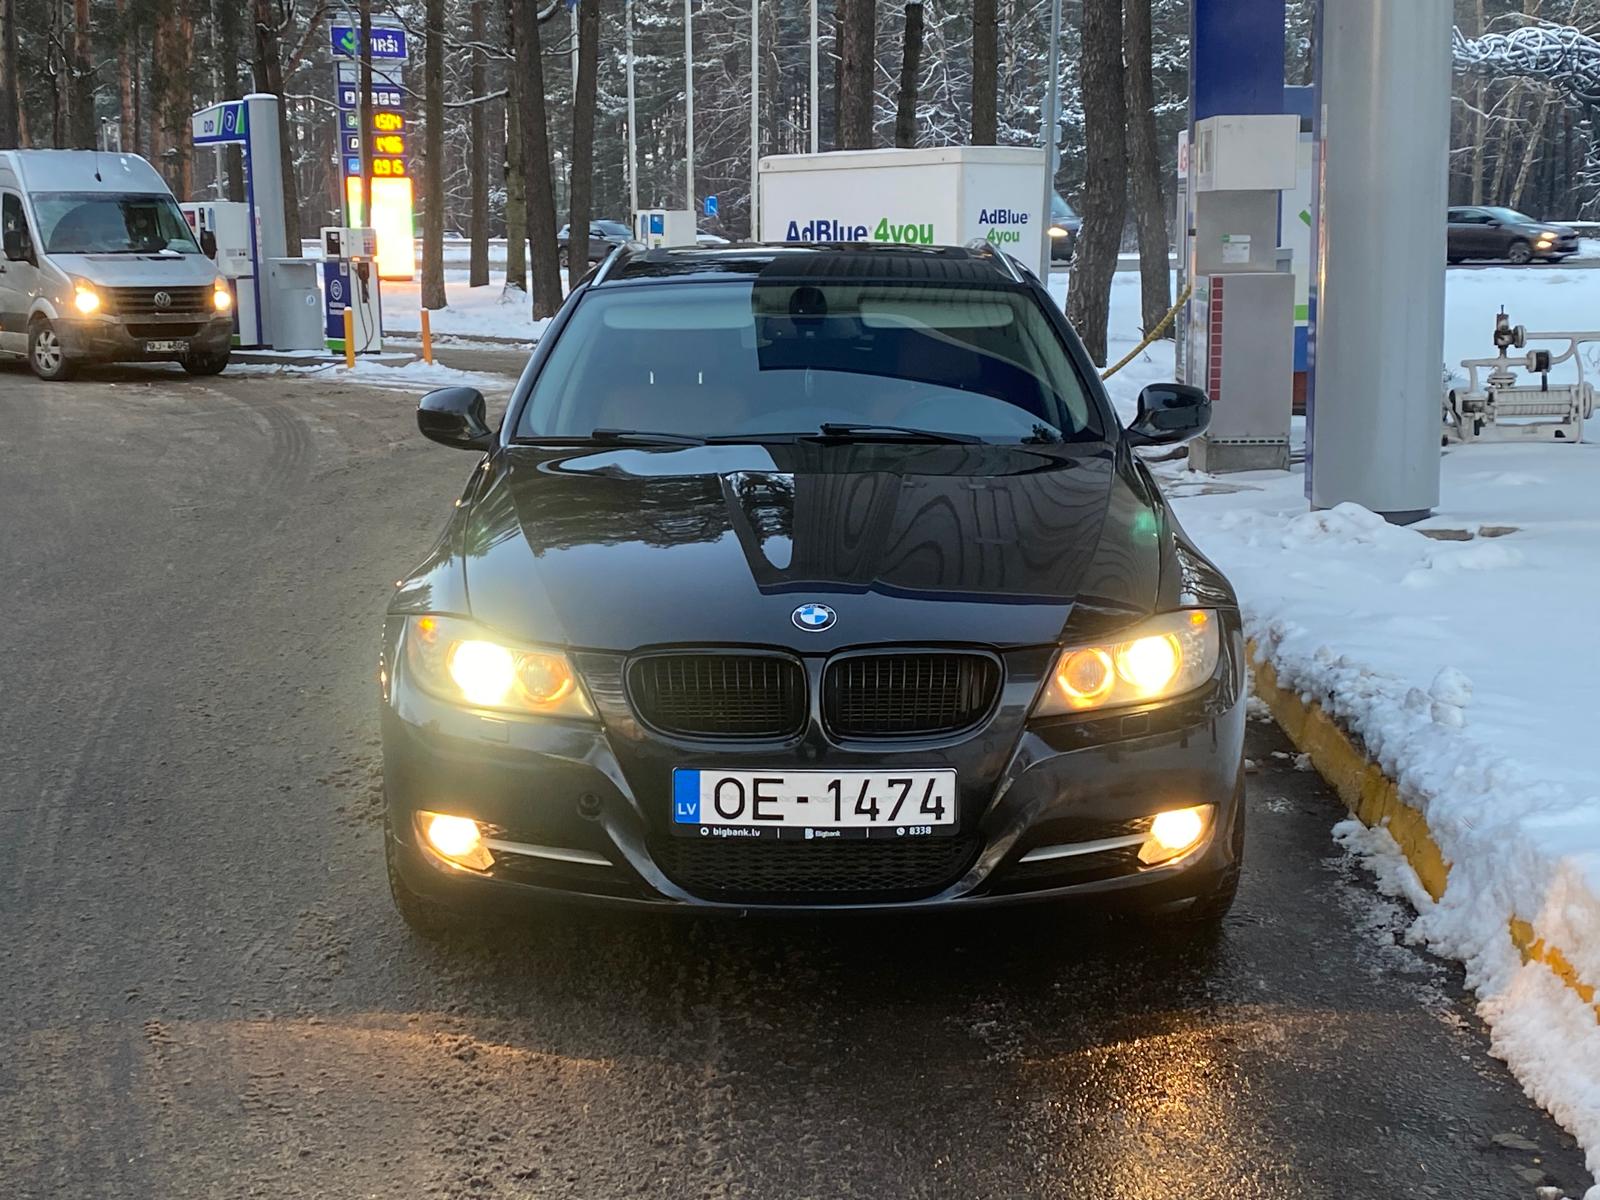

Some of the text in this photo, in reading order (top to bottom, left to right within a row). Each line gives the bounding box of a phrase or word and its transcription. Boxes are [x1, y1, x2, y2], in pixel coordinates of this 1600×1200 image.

[370, 35, 398, 52] IRŠI
[978, 209, 1028, 225] AdBlue
[786, 217, 934, 244] AdBlue 4you
[987, 227, 1020, 247] 4you
[714, 777, 945, 821] OE-1474
[678, 803, 697, 815] LV
[713, 828, 761, 837] bigbank.lv
[909, 827, 932, 835] 8338
